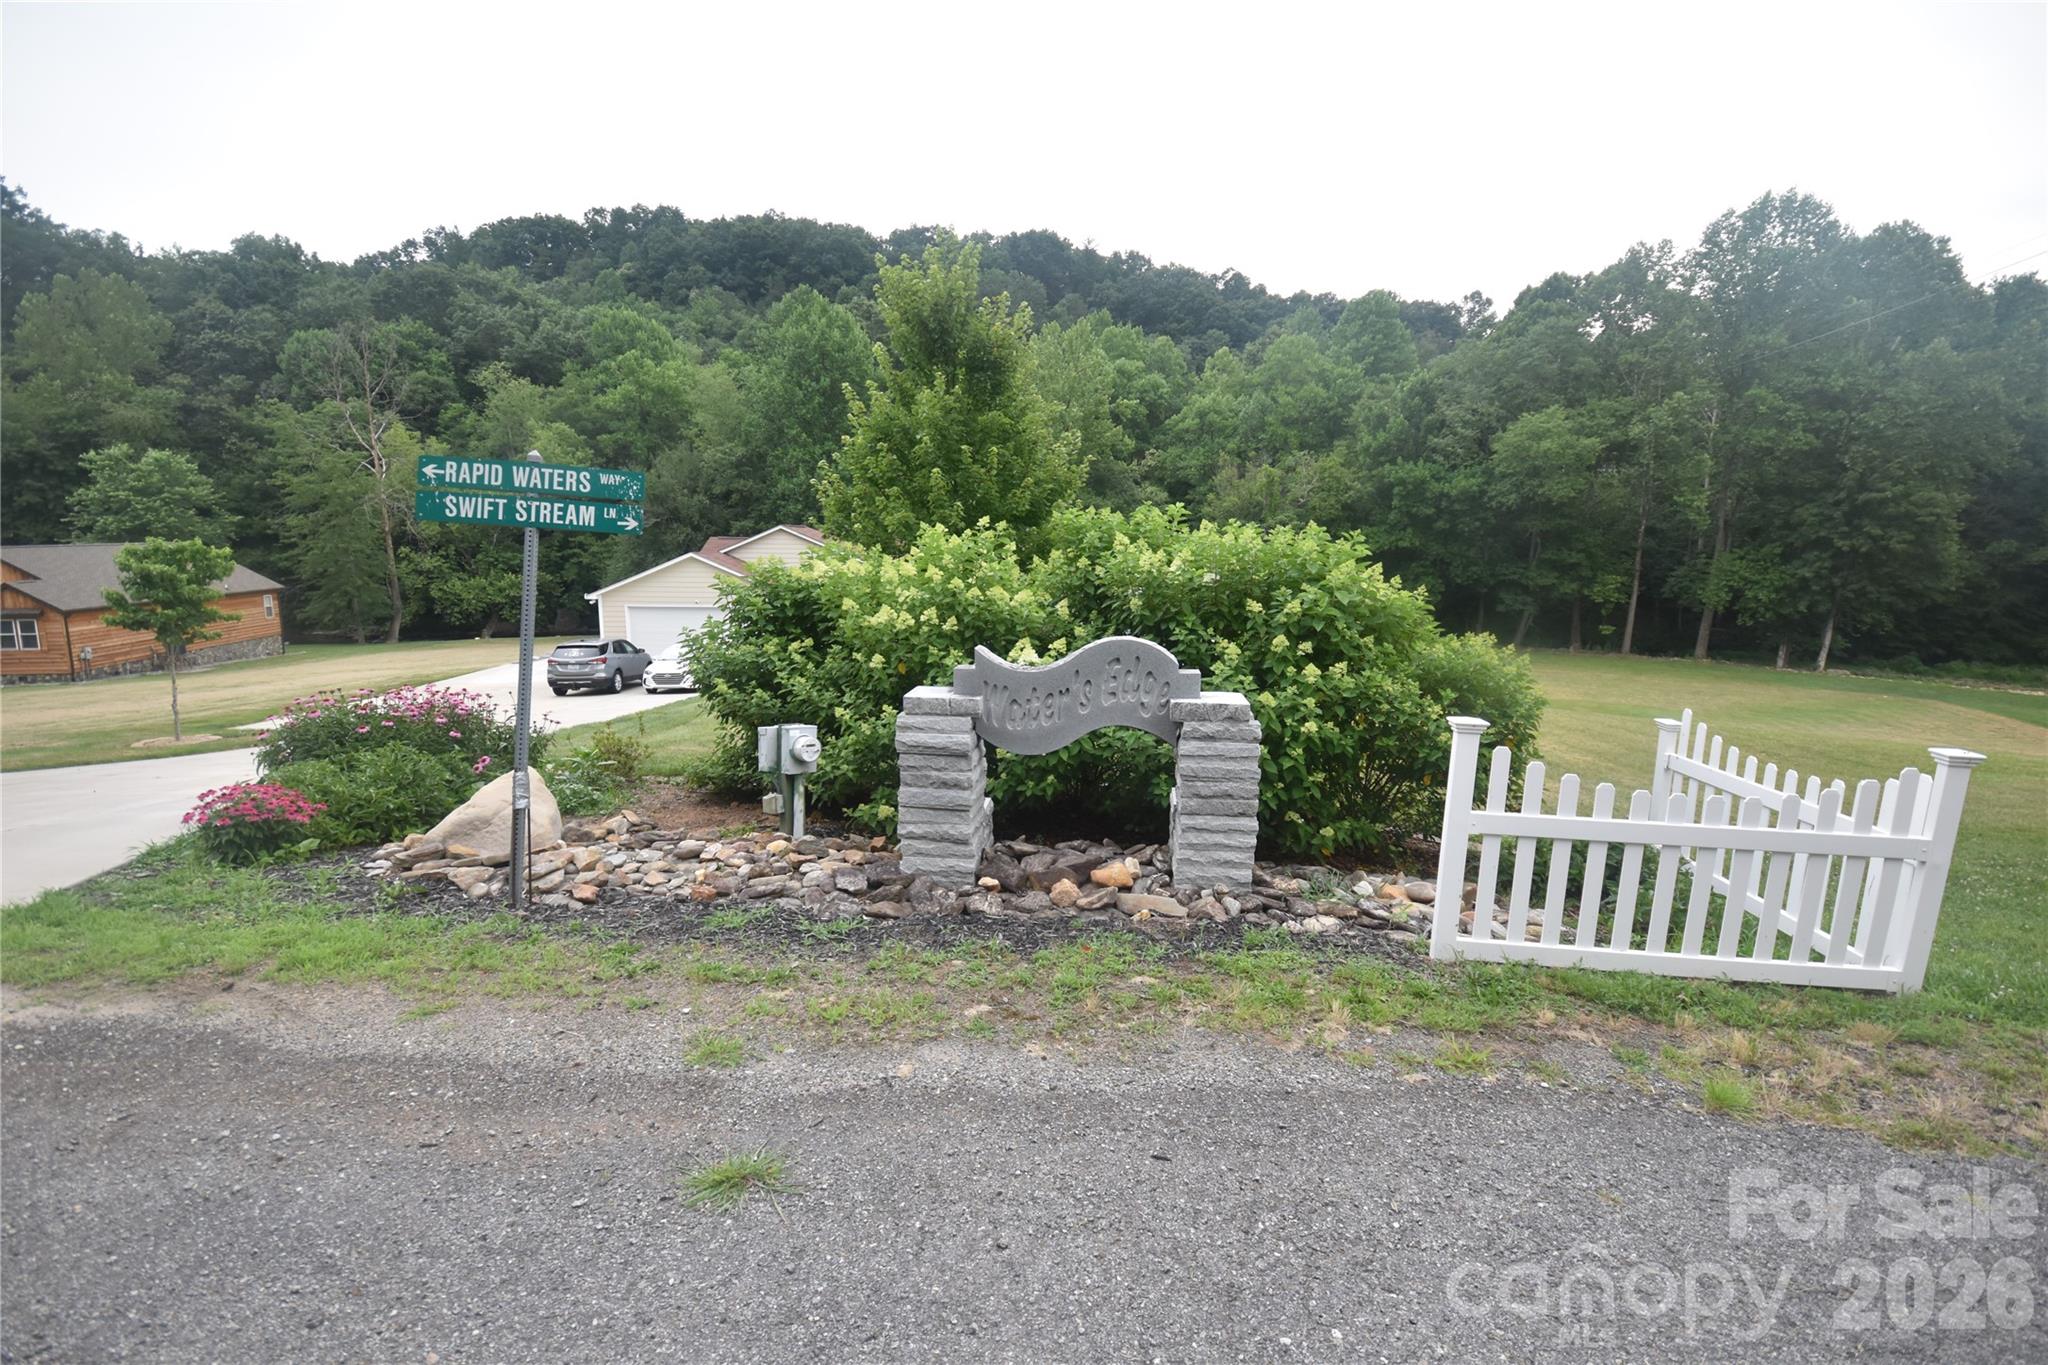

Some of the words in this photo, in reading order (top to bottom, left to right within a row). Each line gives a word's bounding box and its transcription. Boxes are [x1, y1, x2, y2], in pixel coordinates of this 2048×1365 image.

[445, 461, 502, 486] RAPID
[512, 465, 591, 493] WATERS
[600, 473, 621, 486] WAY
[445, 495, 507, 520] SWIFT
[515, 499, 595, 527] STREAM
[603, 507, 616, 519] LN
[982, 669, 1093, 730] Water's
[1101, 655, 1171, 718] Edge
